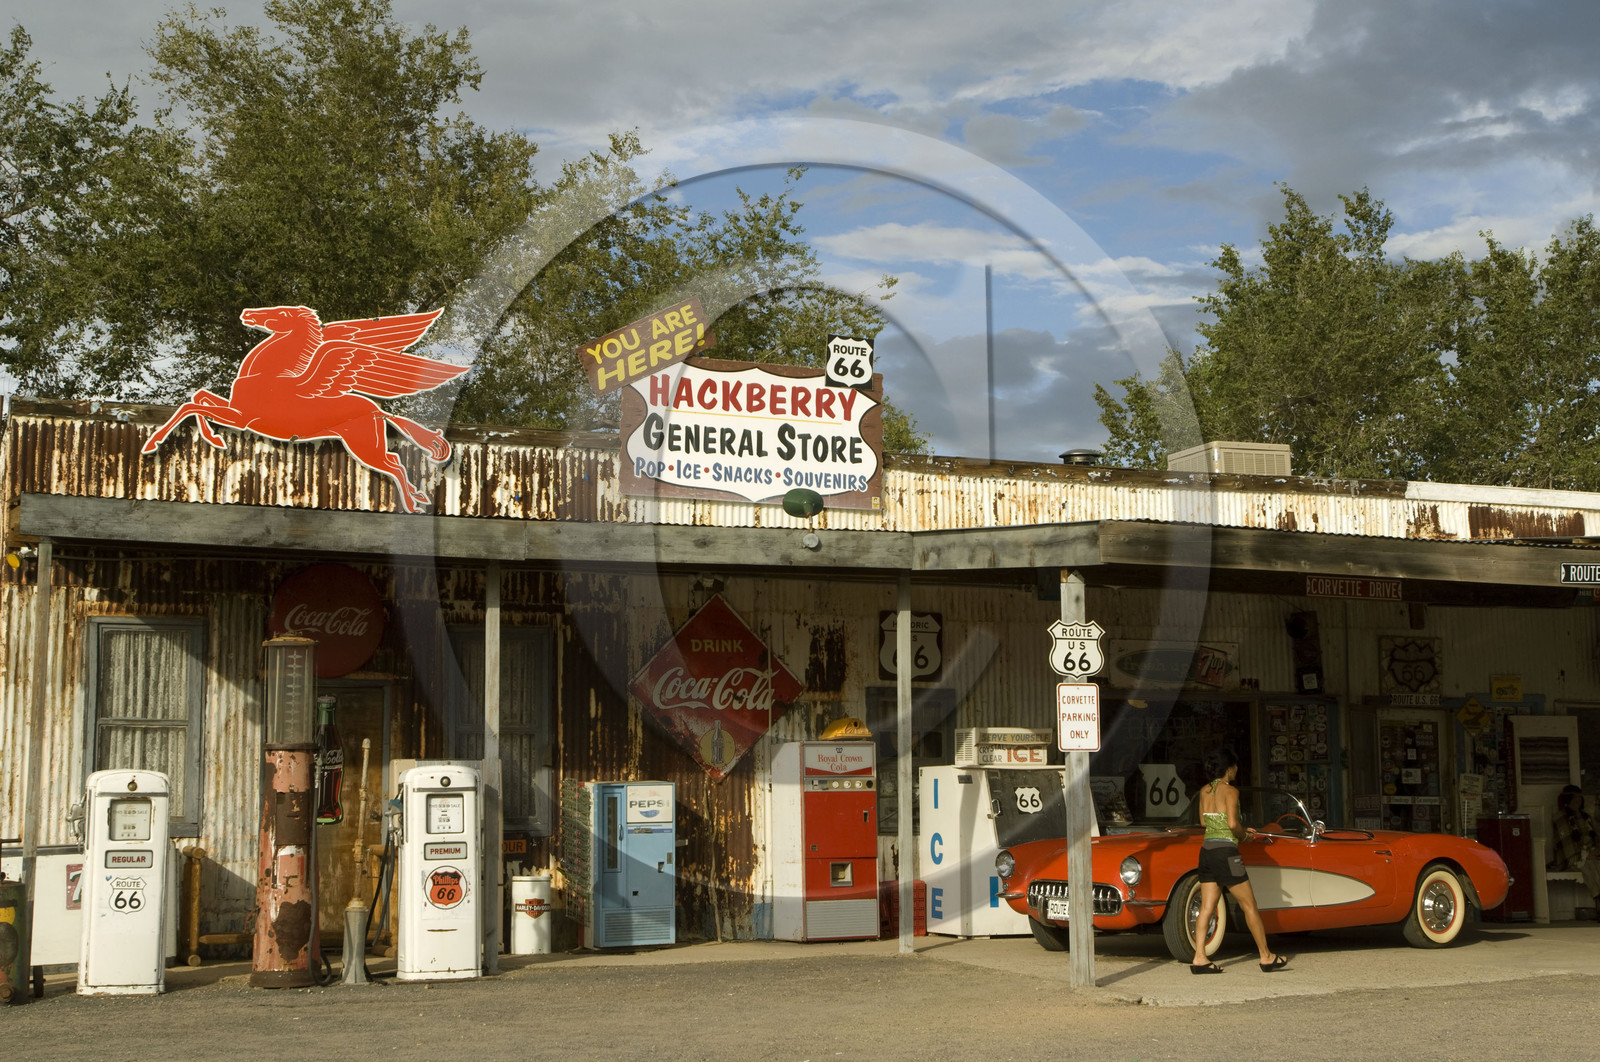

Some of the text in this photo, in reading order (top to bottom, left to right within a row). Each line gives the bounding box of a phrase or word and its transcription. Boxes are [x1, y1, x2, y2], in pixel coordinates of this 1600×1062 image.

[587, 304, 698, 364] YOU ARE
[598, 323, 706, 391] HERE!
[833, 344, 867, 358] ROUTE
[833, 358, 865, 379] 66
[650, 374, 857, 421] HACKBERRY
[643, 412, 863, 465] GENERAL STORE
[635, 457, 868, 492] POP ICE SNACKS SOUVENIRS
[1311, 578, 1398, 598] CORVETTE DRIVE
[284, 603, 375, 638] Coca-Cola
[893, 620, 929, 629] HORIC
[1061, 627, 1093, 639] ROUTE
[691, 639, 744, 654] DRINK
[1063, 653, 1091, 673] 66
[1402, 664, 1425, 683] 66
[652, 666, 779, 712] Coca-Cola
[1062, 694, 1096, 706] CORVETTE
[1393, 694, 1414, 705] ROUTE
[1062, 712, 1097, 723] PARKING
[981, 732, 1050, 742] SERVE YOURSELF
[1070, 728, 1090, 740] ONLY
[818, 754, 862, 764] Royal Crown
[982, 754, 1003, 763] CLEAR
[1007, 745, 1043, 763] ICE
[830, 763, 848, 772] Cola
[1150, 776, 1179, 806] 66
[629, 799, 670, 809] PEPSI
[1019, 794, 1041, 808] 66
[430, 847, 461, 855] PREMIUM
[112, 856, 146, 864] REGULAR
[116, 880, 141, 889] ROUTE
[433, 874, 459, 887] Phillips
[114, 890, 142, 910] 66
[437, 887, 456, 901] 66
[1049, 903, 1067, 915] ROUTE
